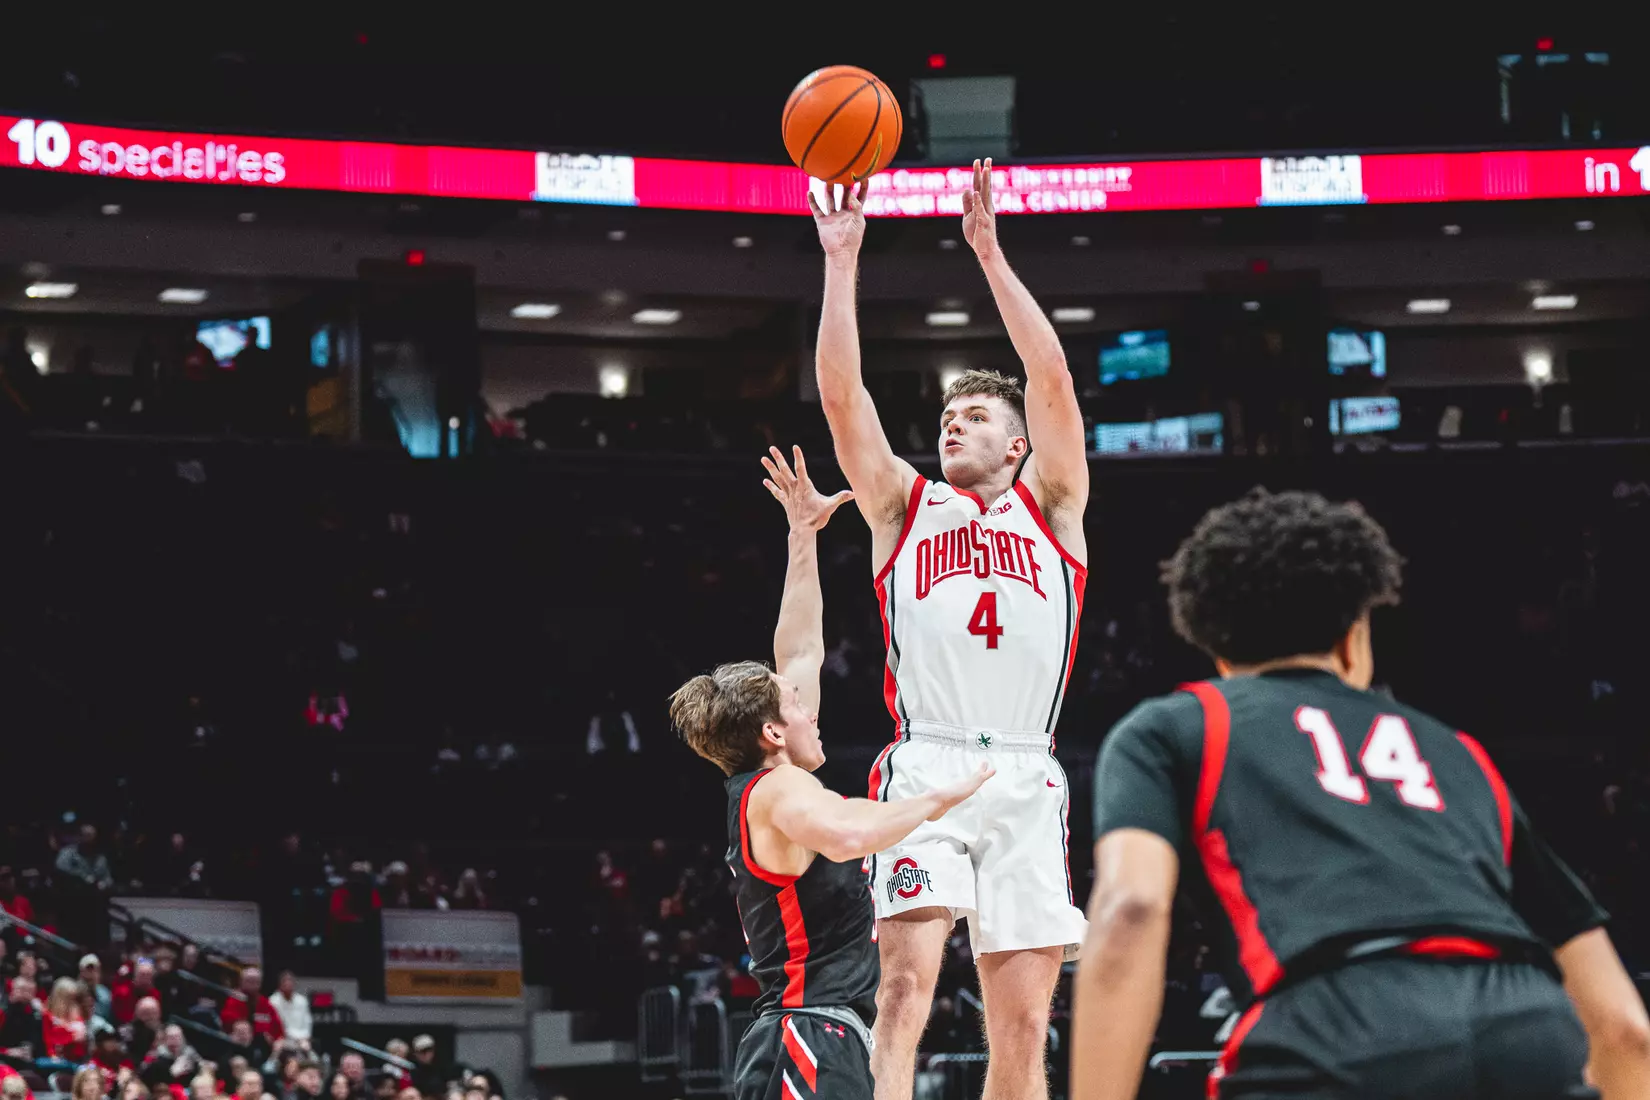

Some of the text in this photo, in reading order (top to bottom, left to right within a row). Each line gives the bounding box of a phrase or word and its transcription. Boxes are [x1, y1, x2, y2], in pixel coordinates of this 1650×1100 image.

[8, 118, 71, 168] 10
[1584, 157, 1620, 193] in
[967, 591, 1004, 650] 4
[1293, 704, 1446, 813] 14
